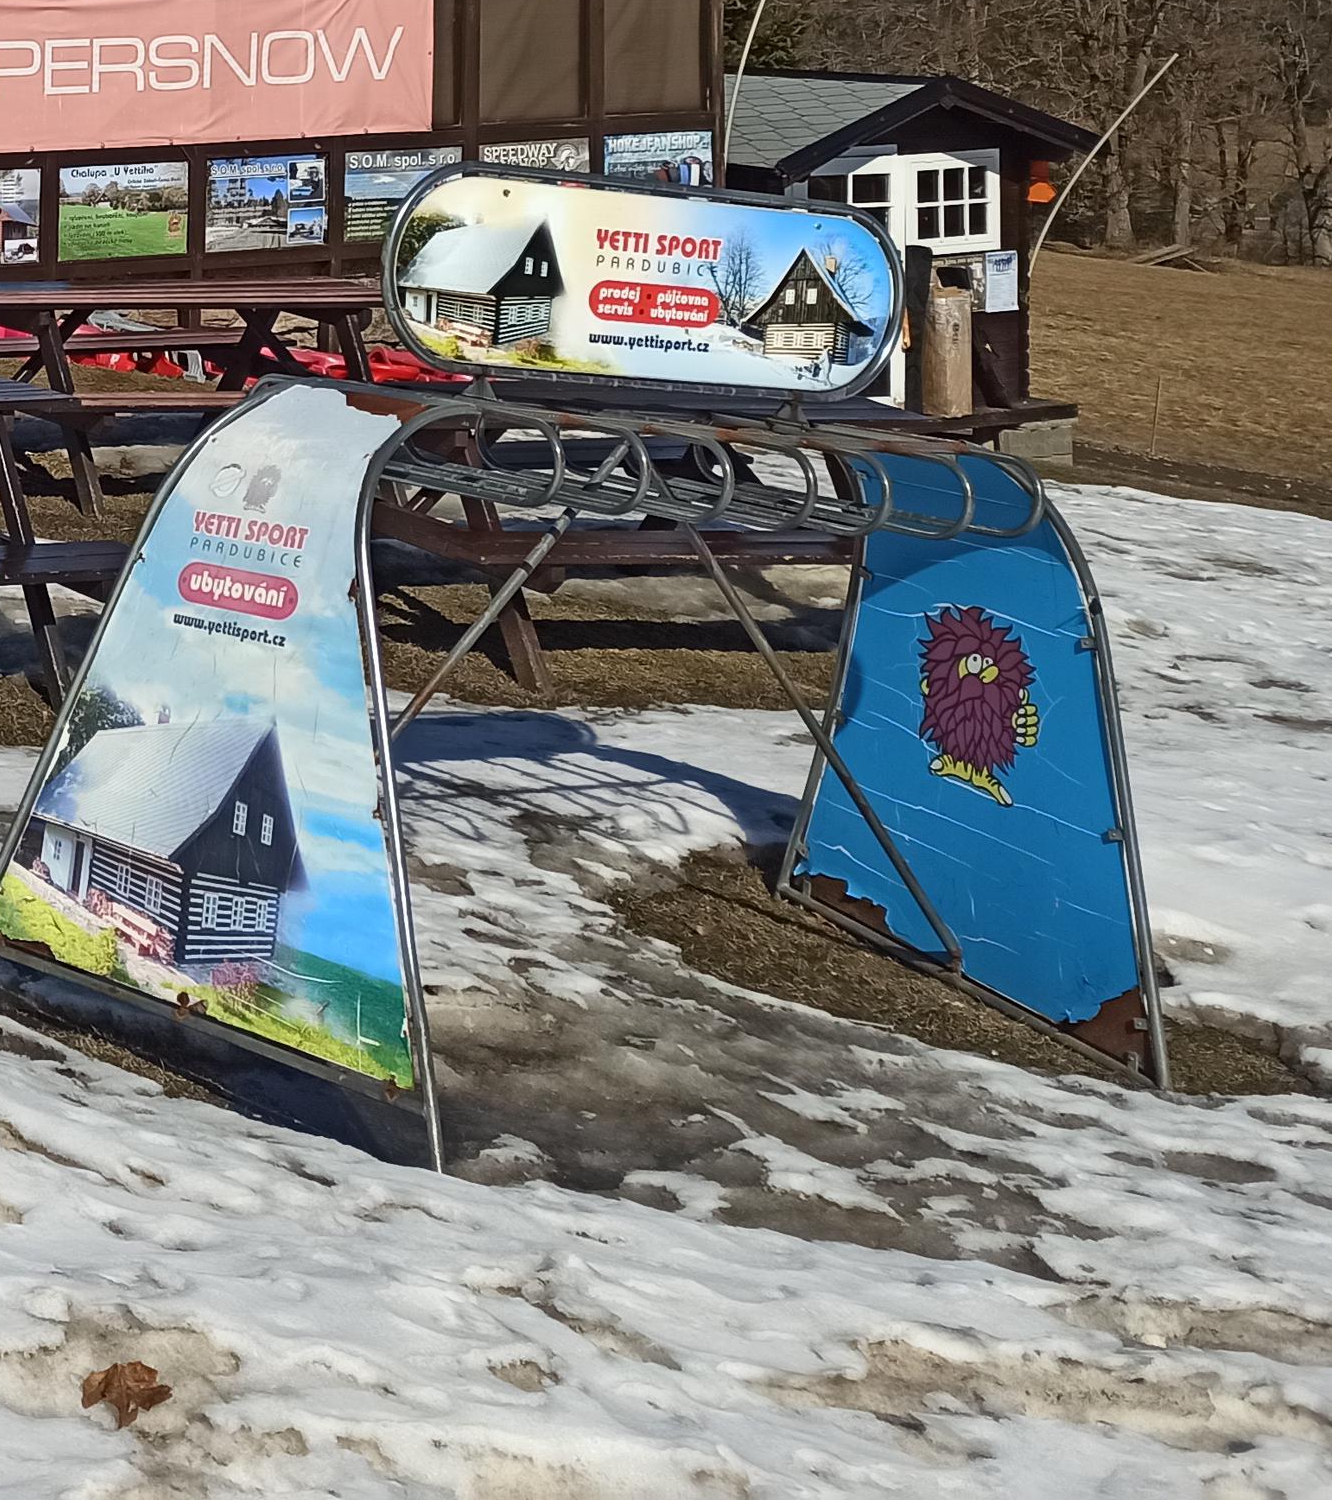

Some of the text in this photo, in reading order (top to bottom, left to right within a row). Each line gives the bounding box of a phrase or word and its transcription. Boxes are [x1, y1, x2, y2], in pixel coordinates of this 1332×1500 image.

[349, 153, 458, 169] S.O.M. spol. s r.o.
[483, 143, 558, 161] SPEEDWAY
[70, 169, 107, 180] Chalupa
[596, 228, 722, 260] YETTI SPORT
[596, 254, 717, 277] PARDUBICE
[599, 286, 709, 306] prodej půjčovna
[596, 302, 709, 322] servis ubytování
[589, 333, 710, 352] www.yettisport.cz
[194, 511, 309, 550] YETTI SPORT
[189, 536, 303, 568] PARDUBICE
[190, 570, 287, 608] ubytování
[173, 613, 287, 648] www.yettisport.cz
